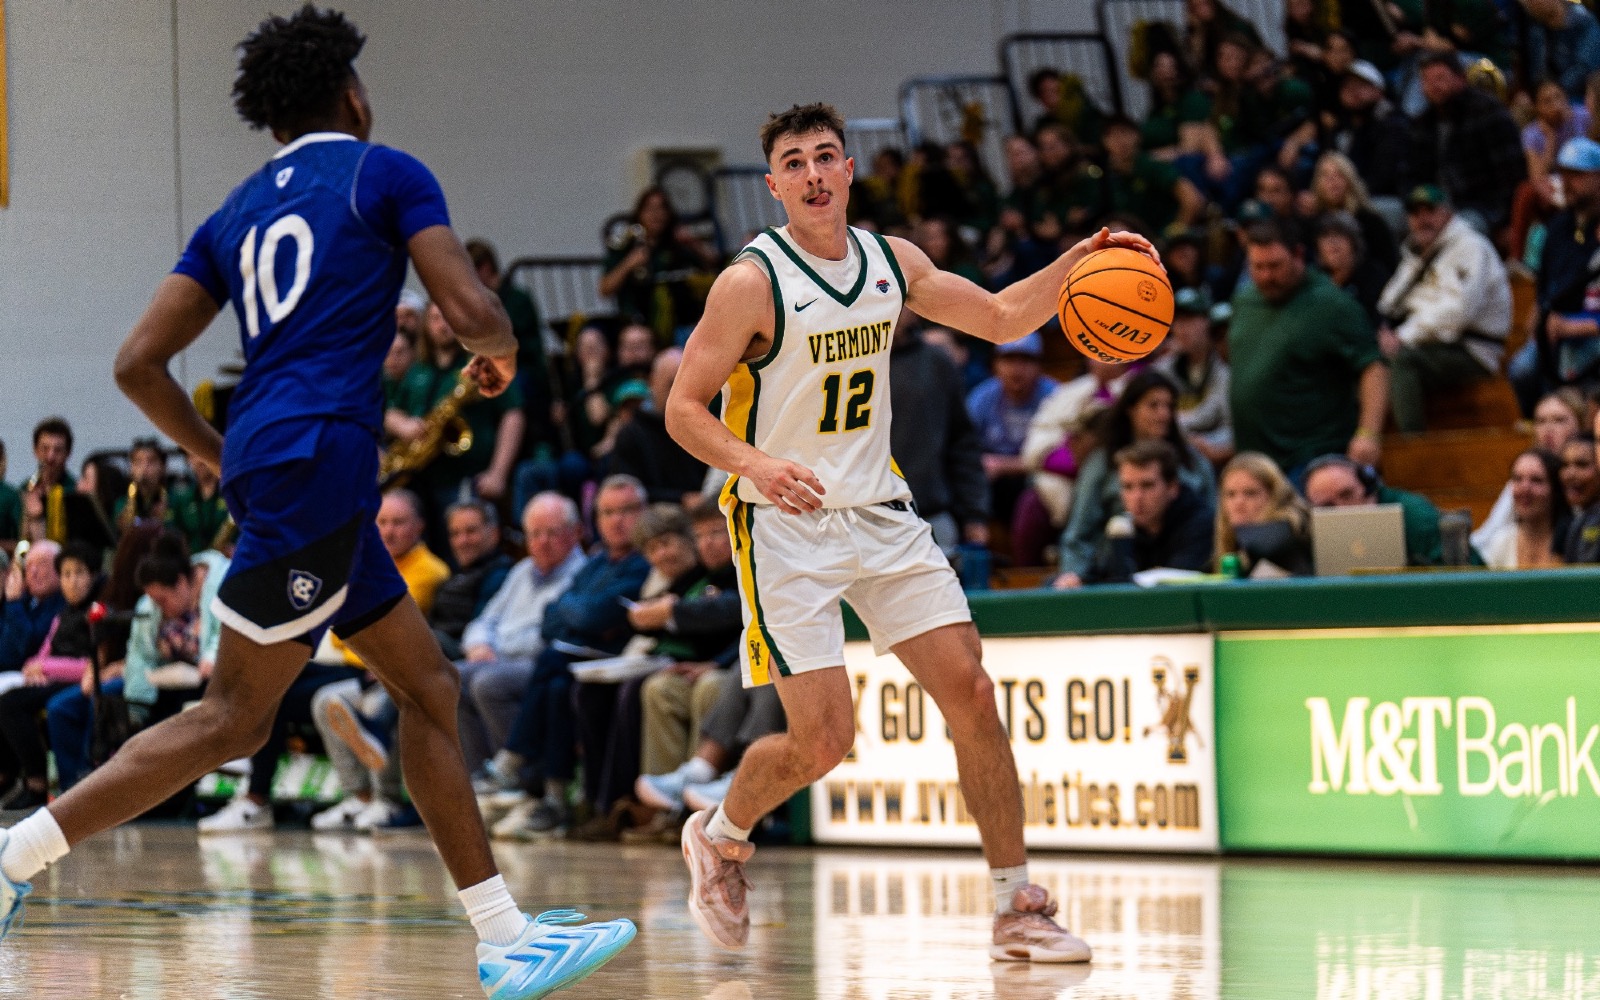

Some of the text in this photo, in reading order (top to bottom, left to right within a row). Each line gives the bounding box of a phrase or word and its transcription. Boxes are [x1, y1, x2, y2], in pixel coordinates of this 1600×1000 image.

[239, 213, 314, 339] 10
[807, 320, 892, 365] VERMONT
[817, 368, 876, 434] 12
[881, 682, 924, 742] GO
[1067, 678, 1132, 742] GO!
[1305, 695, 1600, 798] M&T Bank
